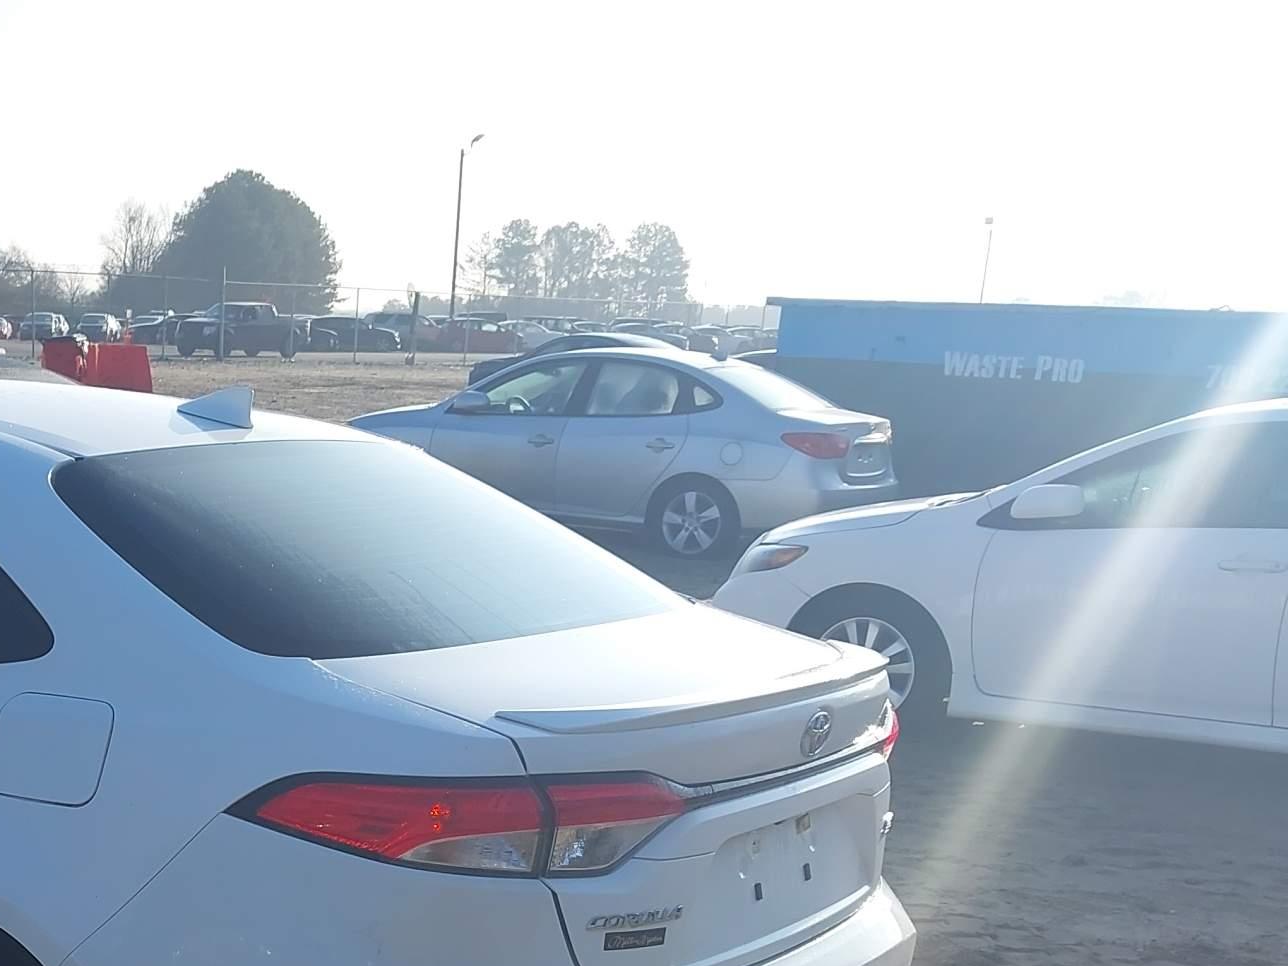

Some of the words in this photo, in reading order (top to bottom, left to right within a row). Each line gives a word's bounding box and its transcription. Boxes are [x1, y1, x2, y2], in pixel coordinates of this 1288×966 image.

[943, 350, 1024, 379] WASTE
[1034, 354, 1085, 383] PRO
[585, 904, 683, 931] COROLLA
